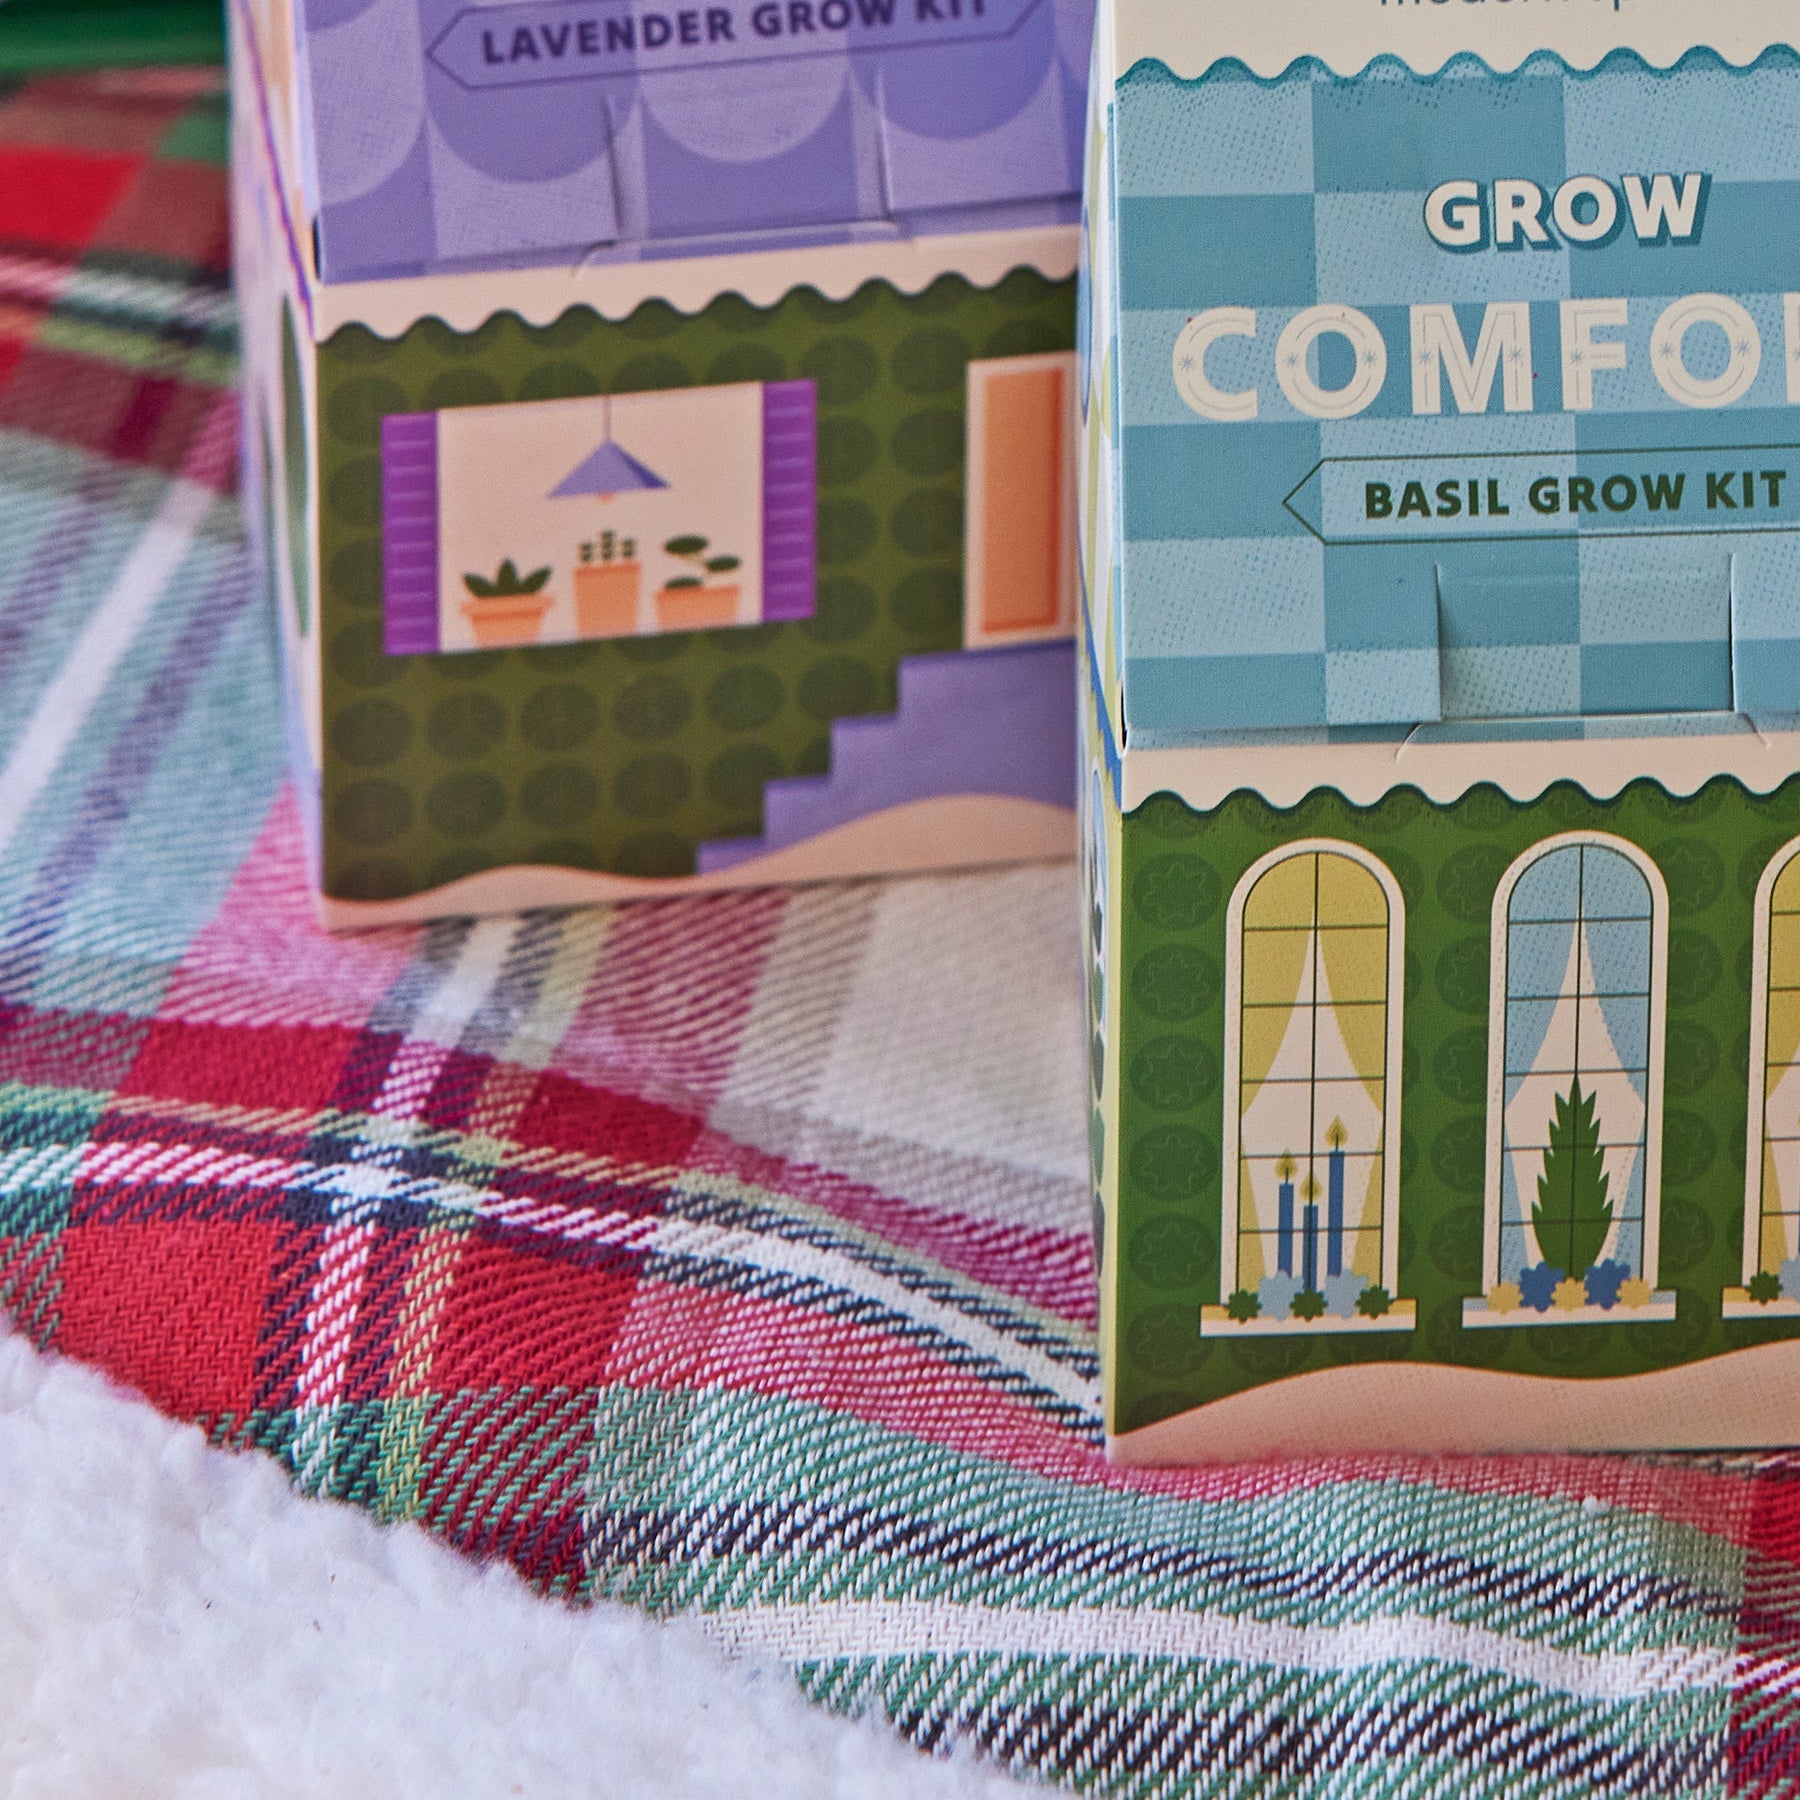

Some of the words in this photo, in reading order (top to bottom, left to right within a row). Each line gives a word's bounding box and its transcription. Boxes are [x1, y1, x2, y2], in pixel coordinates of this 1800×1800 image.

[481, 7, 735, 66] LAVENDER
[1423, 172, 1712, 252] GROW
[1364, 478, 1511, 521] BASIL
[1527, 473, 1686, 515] GROW
[1704, 470, 1788, 509] KIT
